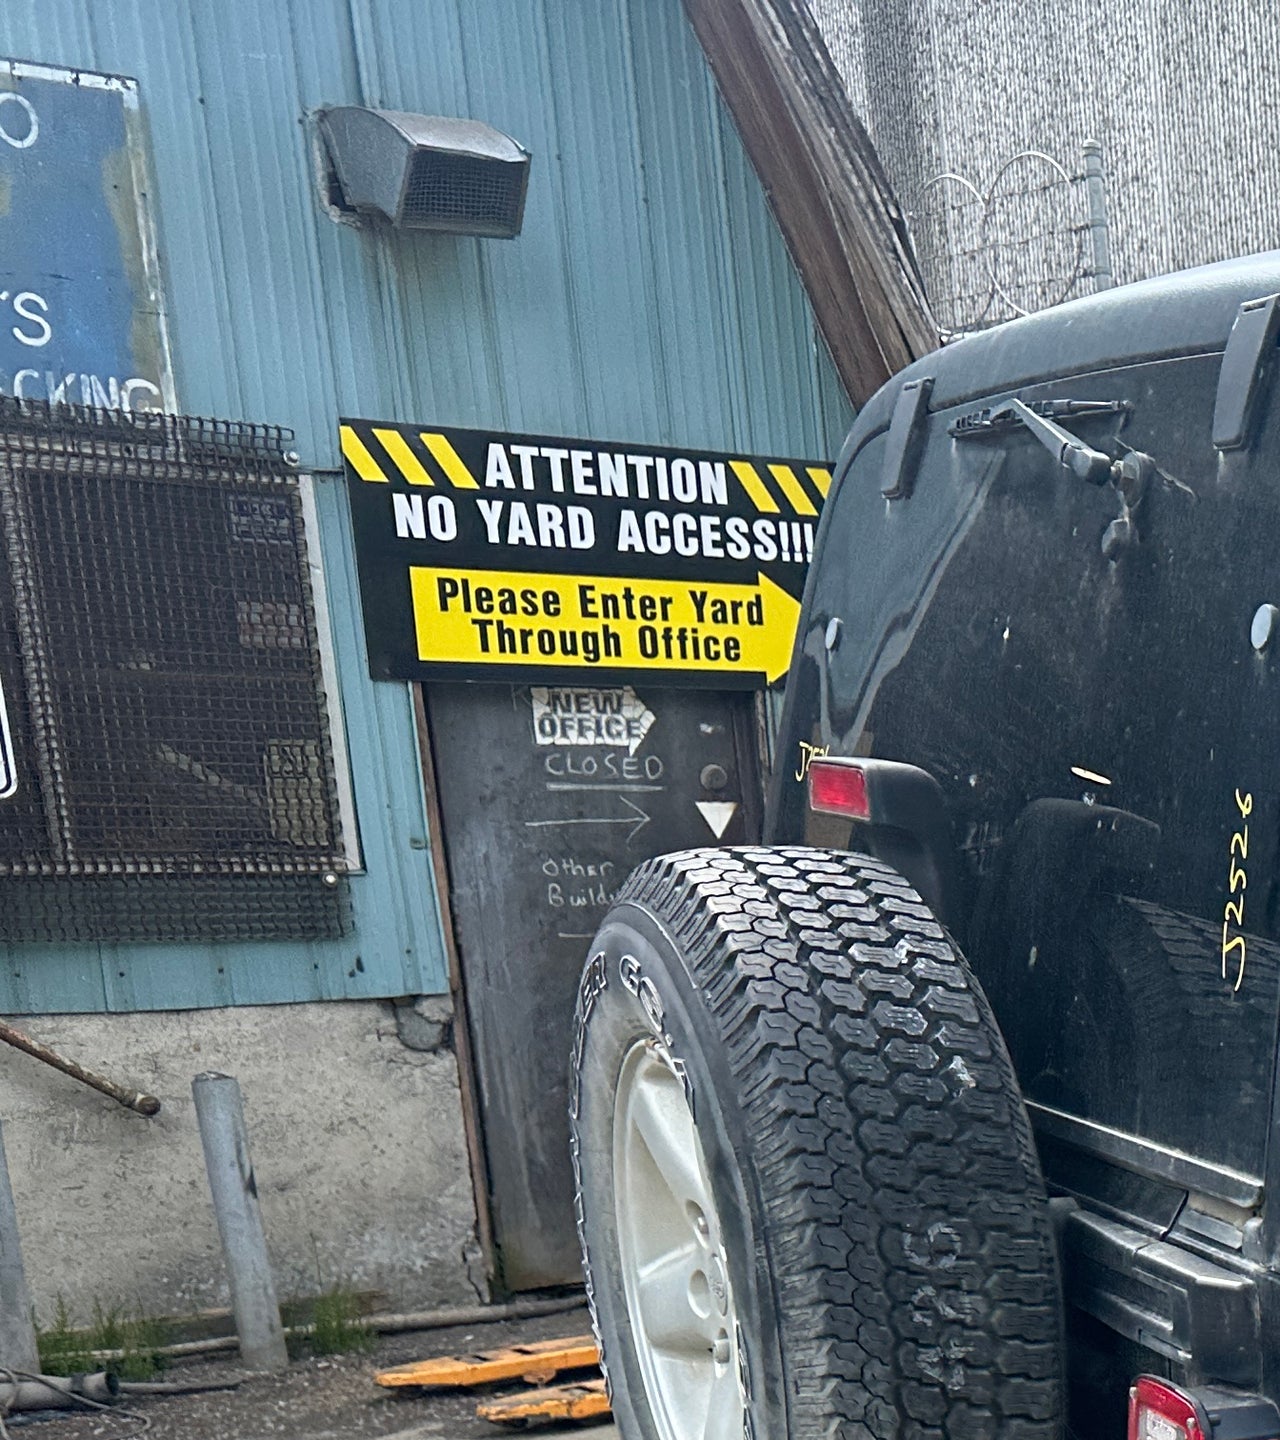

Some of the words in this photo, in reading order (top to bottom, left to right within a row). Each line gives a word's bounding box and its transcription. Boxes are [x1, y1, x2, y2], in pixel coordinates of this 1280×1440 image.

[0, 291, 51, 347] S
[0, 368, 164, 427] CKING
[485, 443, 729, 506] ATTENTION
[392, 493, 457, 542] NO
[476, 499, 596, 549] YARD
[617, 510, 815, 564] ACCESS!!!
[436, 577, 561, 618] Please
[578, 584, 673, 621] Enter
[688, 590, 764, 626] Yard
[471, 619, 622, 663] Through
[638, 625, 741, 662] Office
[538, 713, 644, 739] OFFICE
[551, 692, 625, 715] NEW
[545, 753, 664, 780] CLOSED
[548, 882, 615, 907] Build
[1222, 788, 1252, 992] J2526
